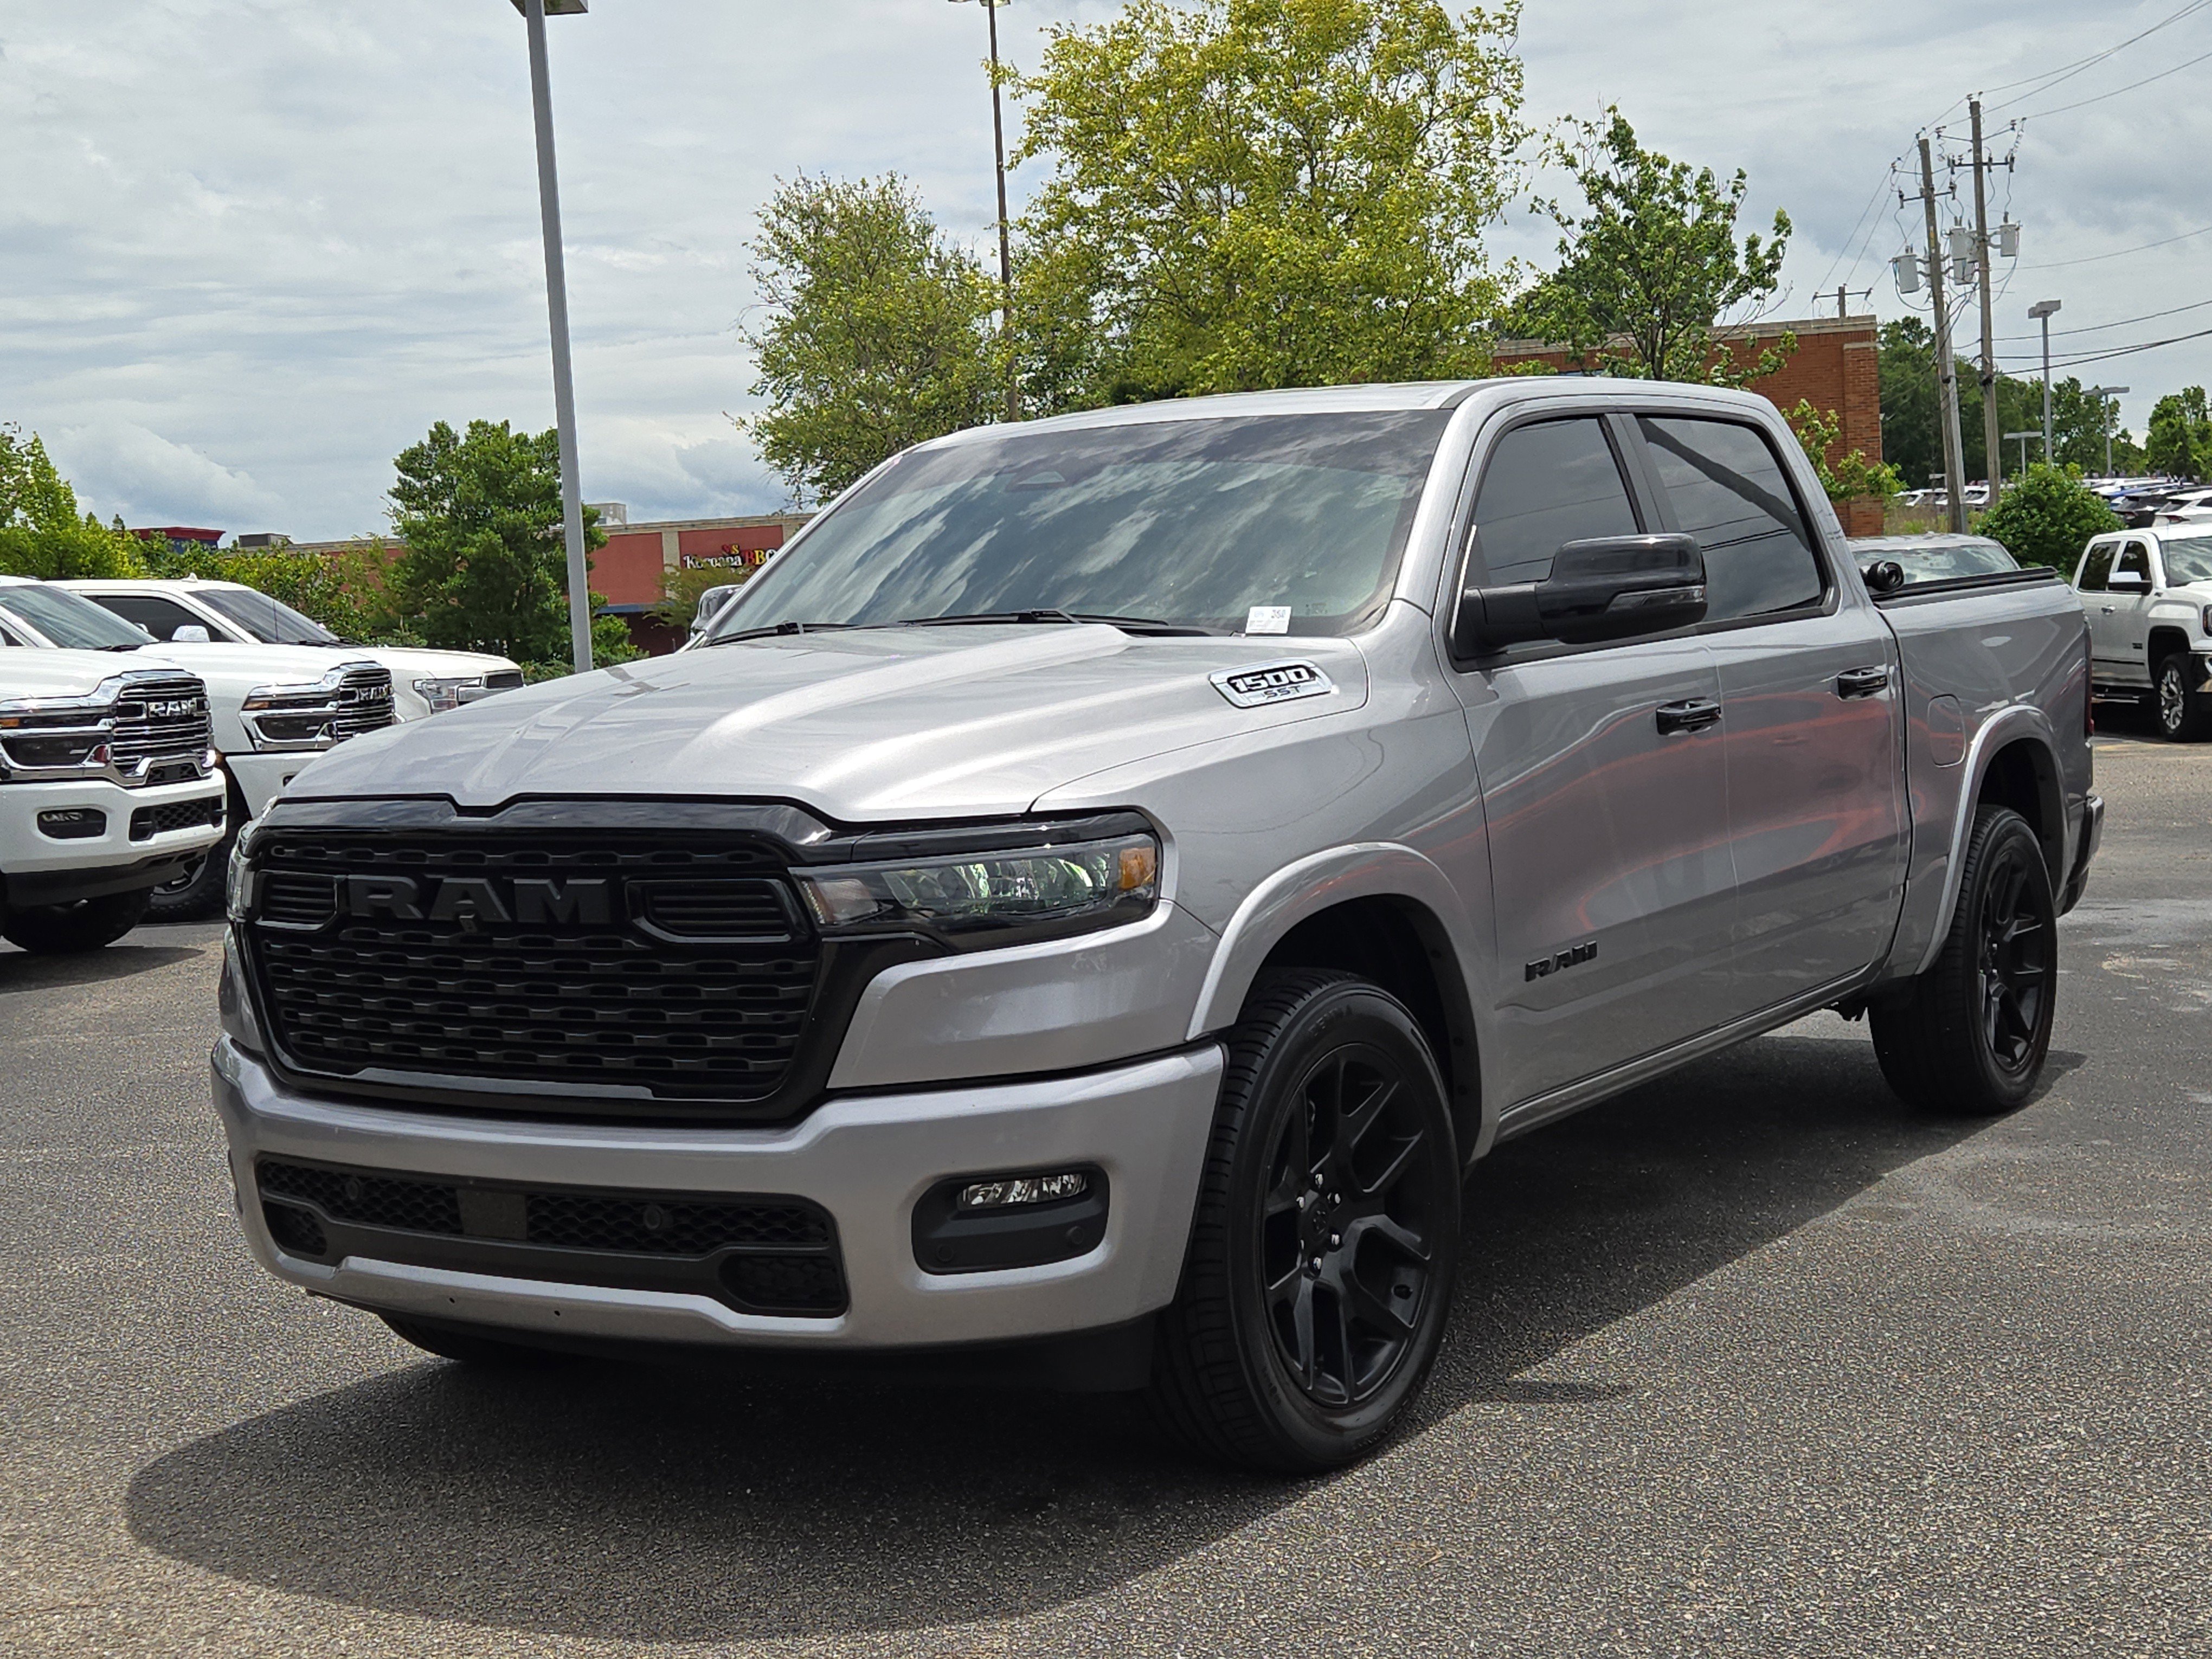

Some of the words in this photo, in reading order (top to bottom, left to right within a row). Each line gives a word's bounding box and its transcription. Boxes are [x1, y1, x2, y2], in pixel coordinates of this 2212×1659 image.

[1230, 667, 1310, 692] 1500
[147, 697, 197, 718] RAM
[347, 874, 609, 923] RAM
[1525, 940, 1597, 982] RAM
